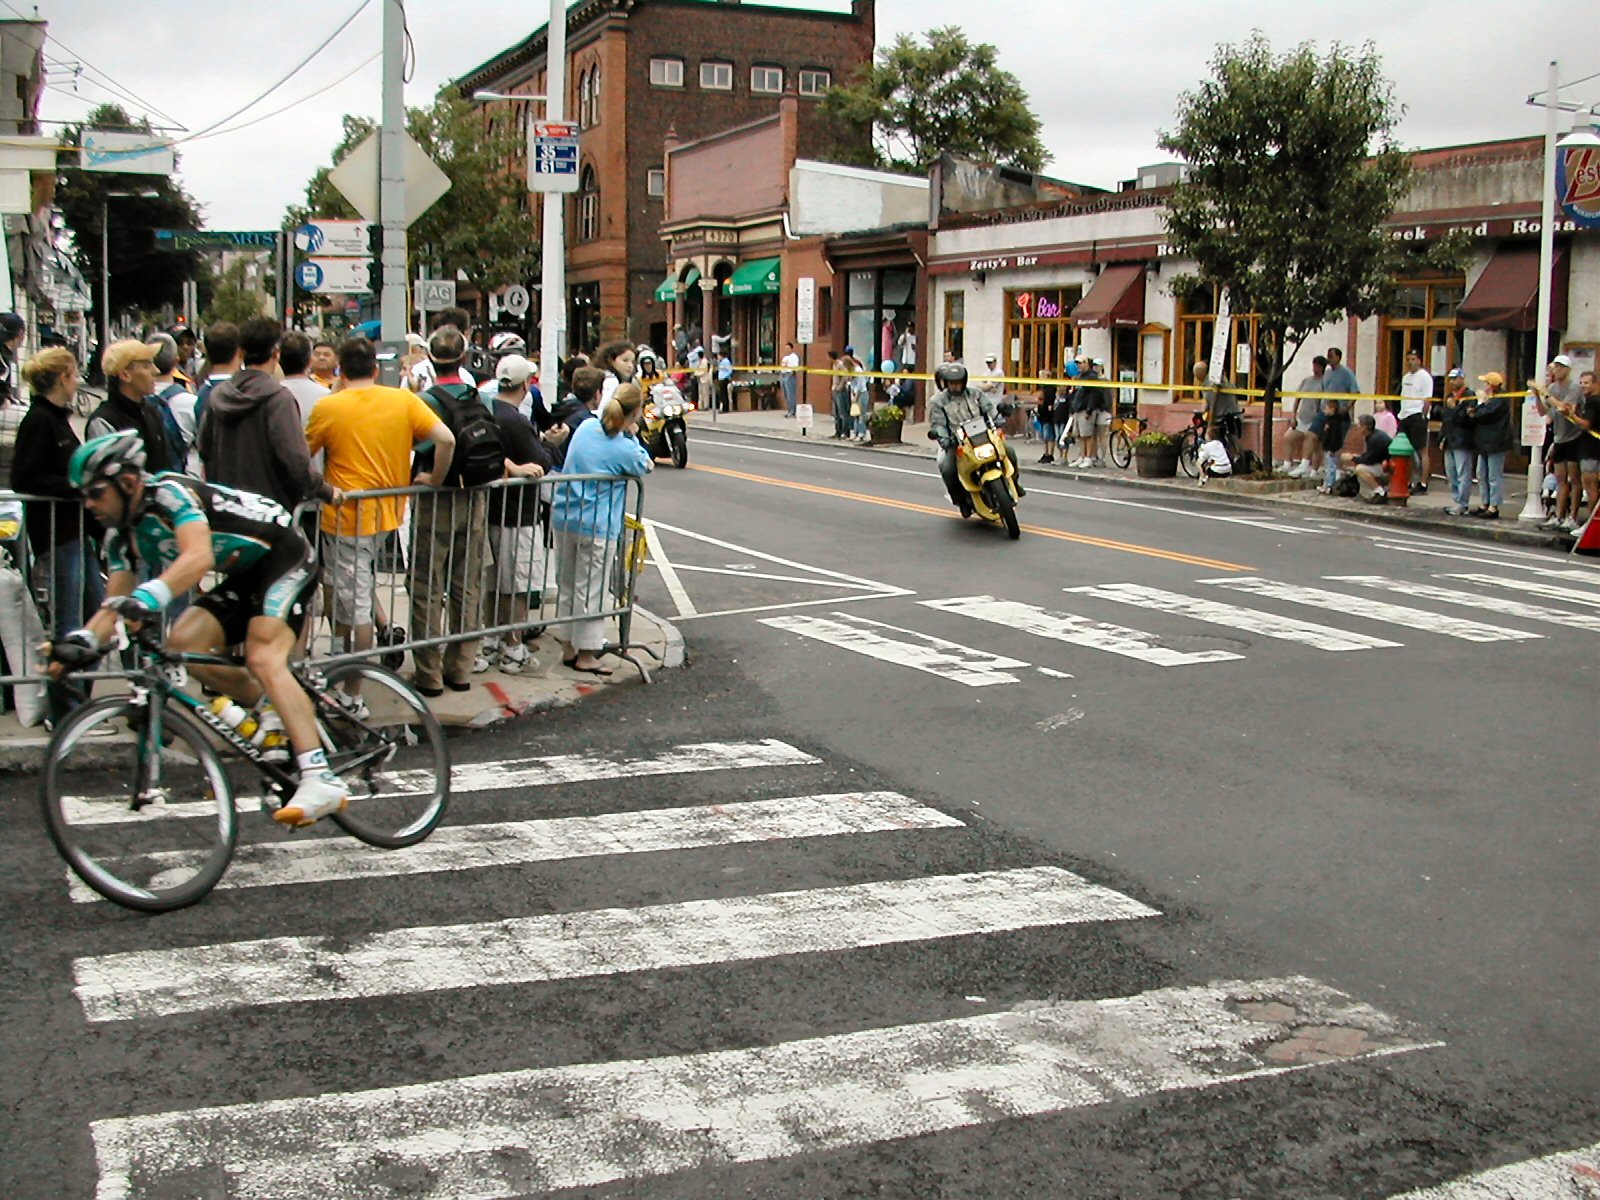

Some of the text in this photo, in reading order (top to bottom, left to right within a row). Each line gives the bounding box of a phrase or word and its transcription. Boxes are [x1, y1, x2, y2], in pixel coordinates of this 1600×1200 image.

[541, 145, 556, 158] 35
[541, 160, 555, 173] 61
[969, 256, 1038, 271] Zesty's Bar
[1036, 297, 1061, 317] Bar
